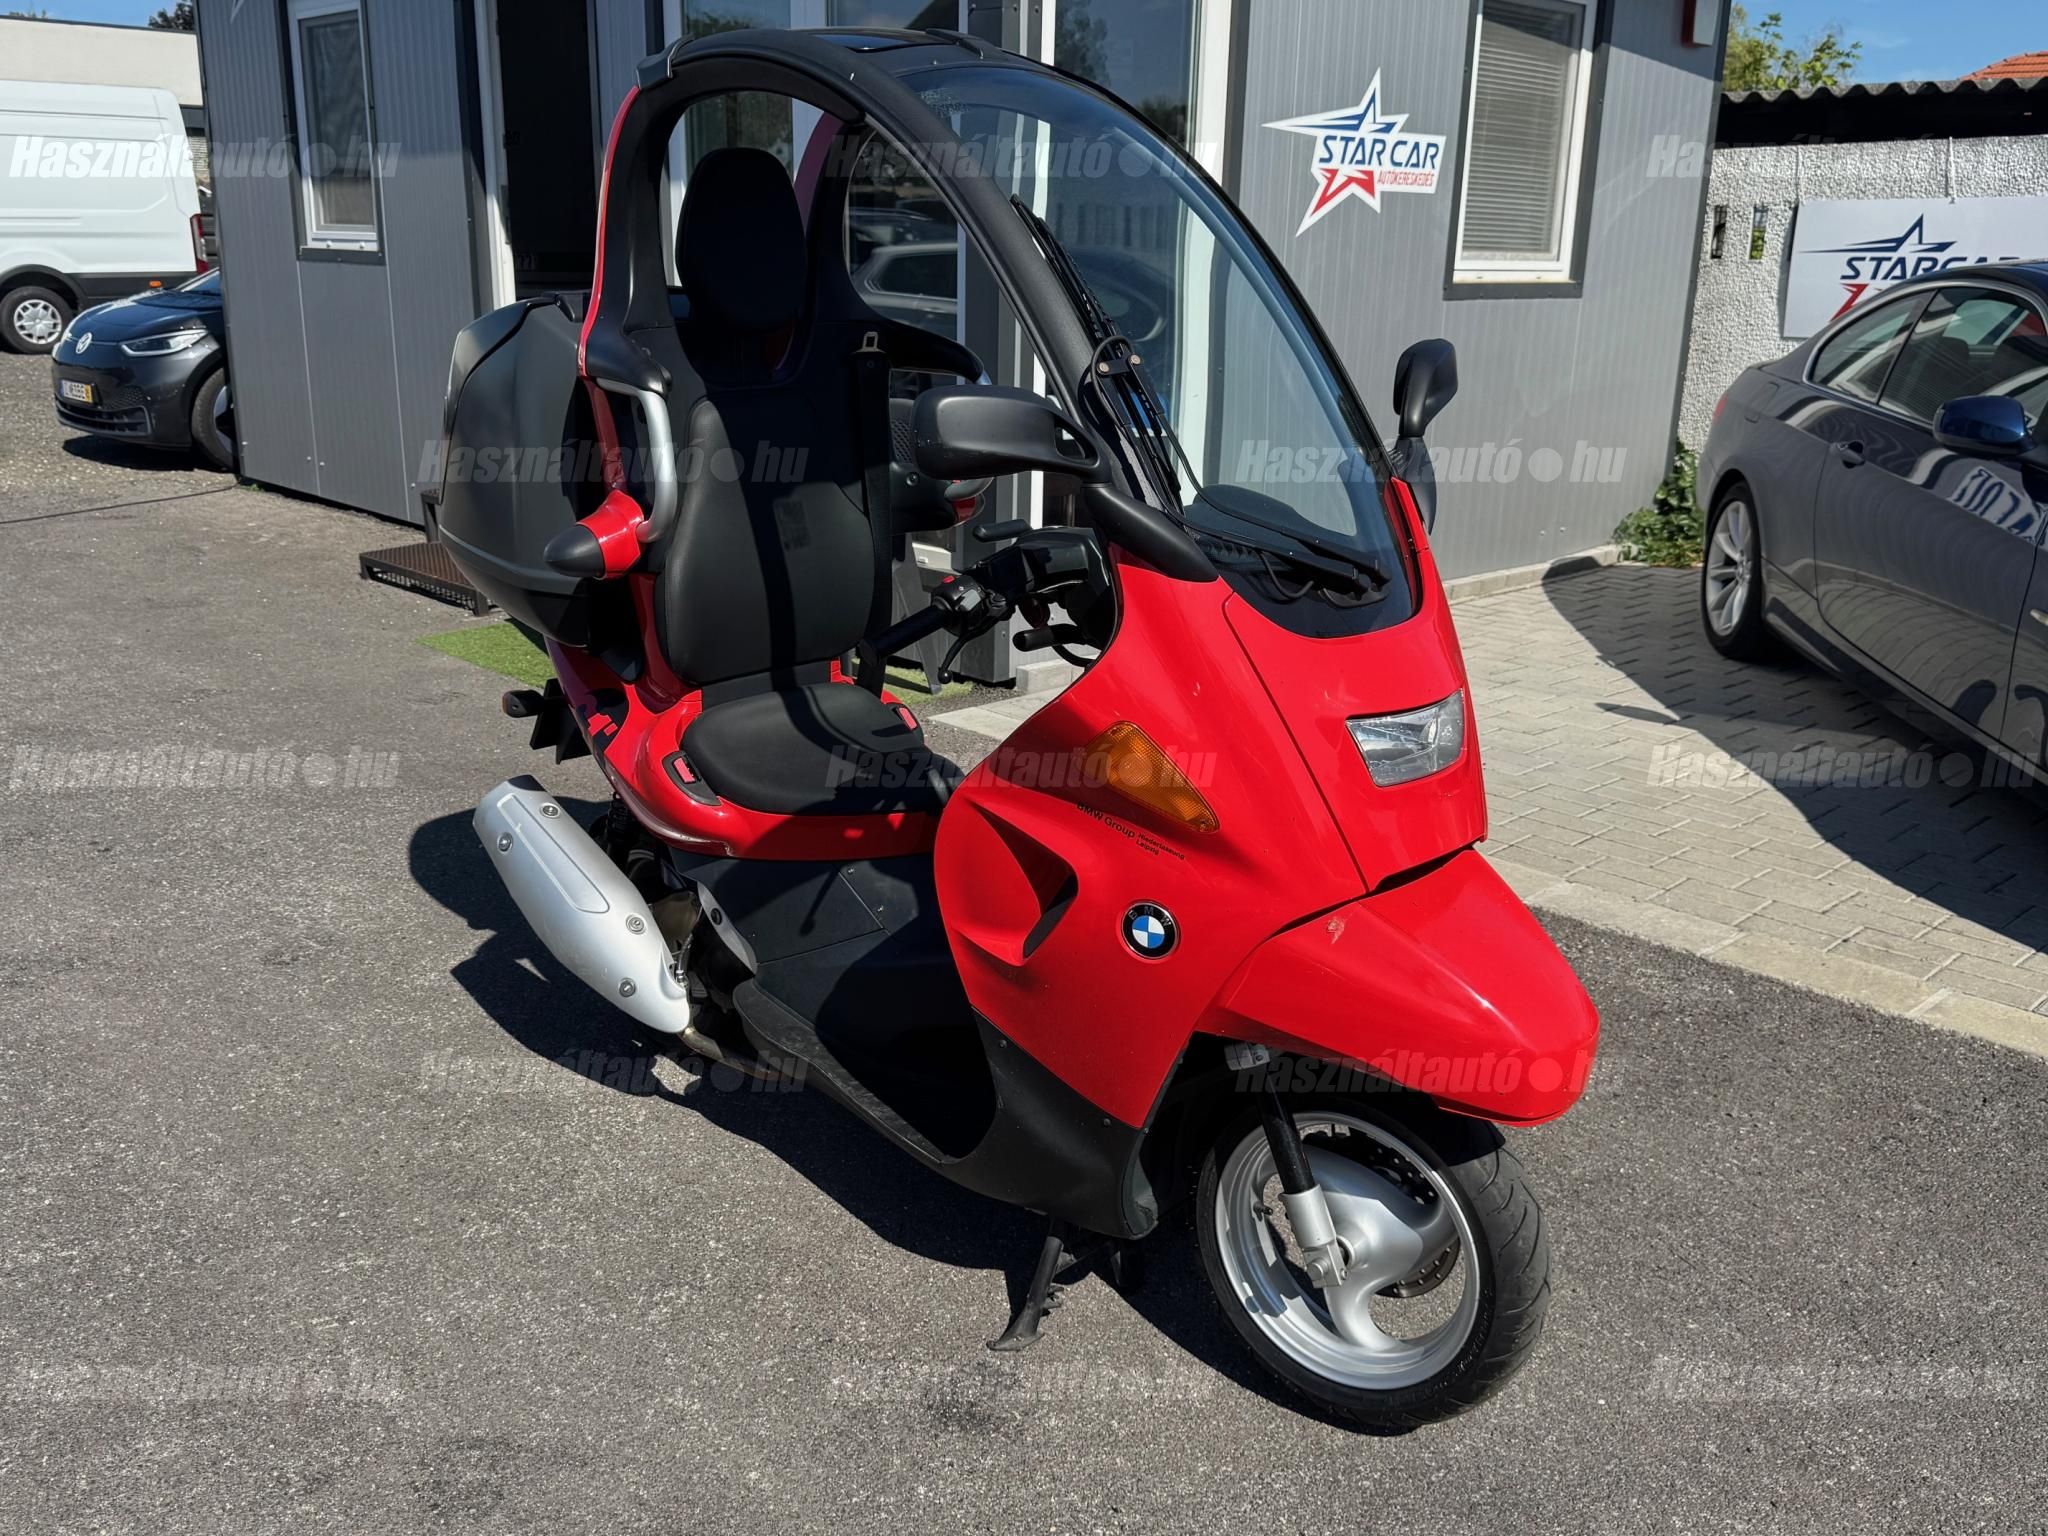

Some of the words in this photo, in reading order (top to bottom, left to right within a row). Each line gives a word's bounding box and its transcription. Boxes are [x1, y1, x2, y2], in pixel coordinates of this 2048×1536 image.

[1077, 801, 1104, 821] BMW
[1104, 816, 1136, 839] Group
[1136, 839, 1160, 856] Leipzig
[1127, 905, 1172, 927] BMW
